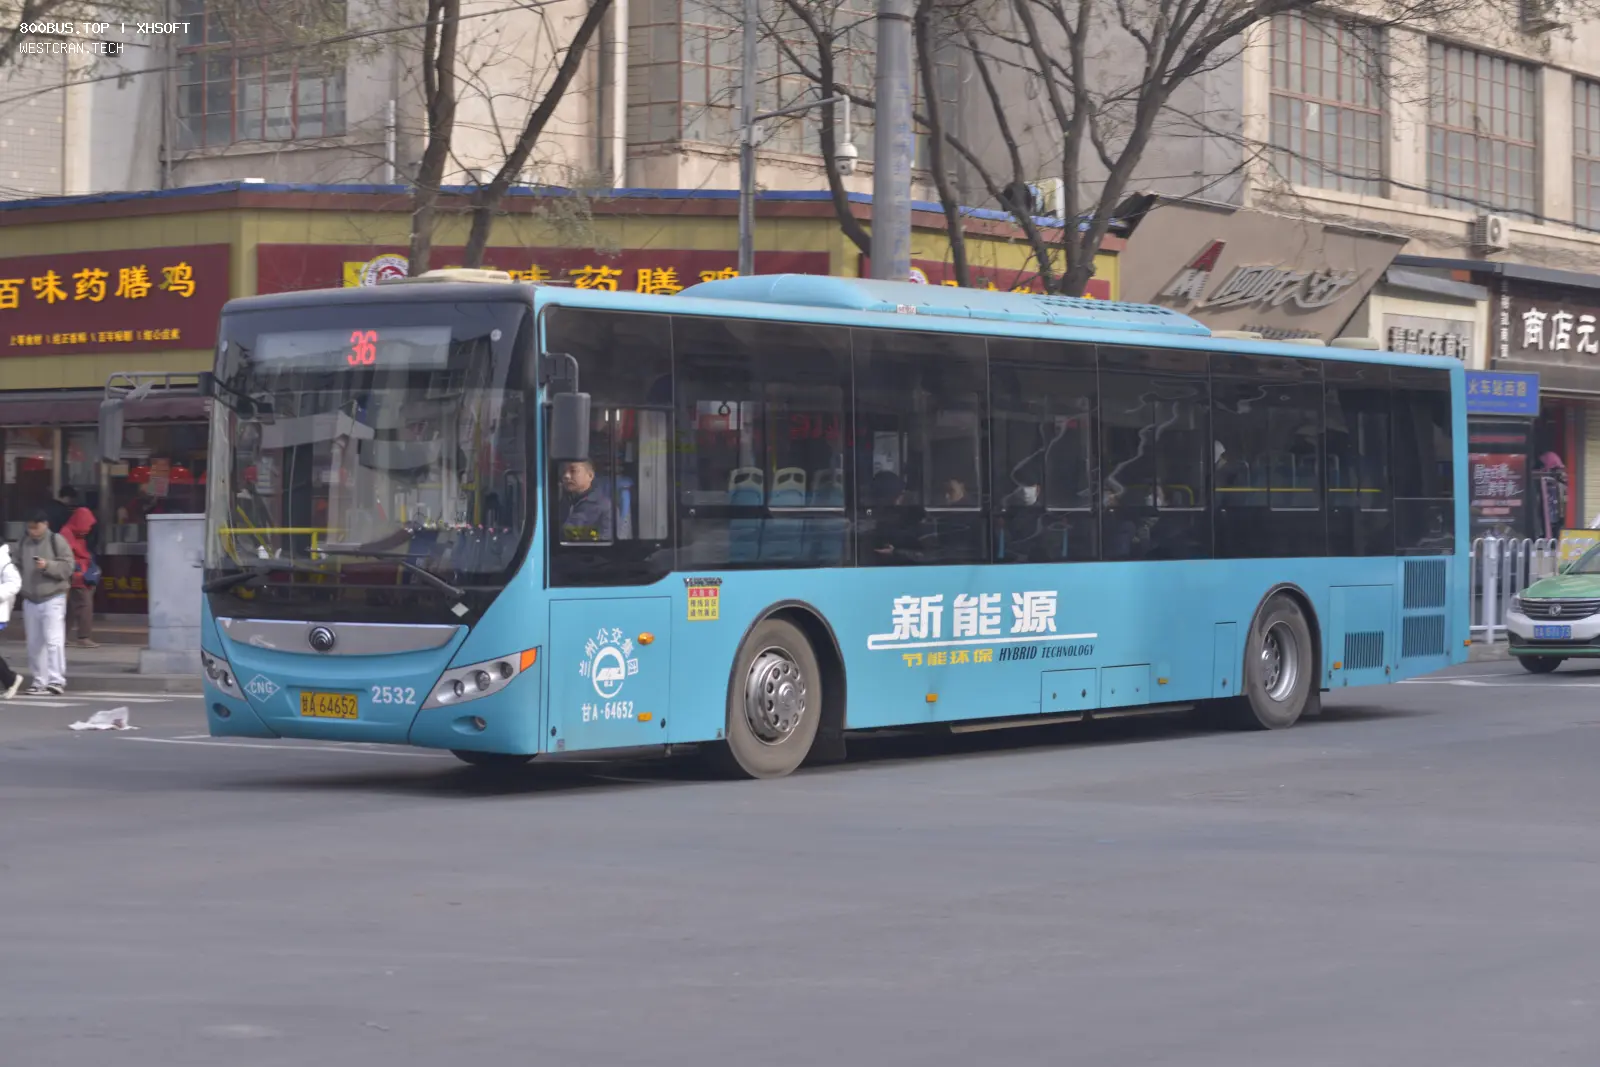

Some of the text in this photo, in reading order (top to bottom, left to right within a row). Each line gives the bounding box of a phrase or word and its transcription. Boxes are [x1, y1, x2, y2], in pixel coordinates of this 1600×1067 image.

[0, 261, 196, 309] 百味药膳鸡
[1522, 307, 1599, 354] 商店元
[347, 329, 377, 366] 36
[890, 590, 1059, 641] 新能源
[902, 648, 993, 667] 节能环保
[999, 644, 1095, 661] HYBRID TECHNOLOGY
[249, 682, 274, 694] CNG
[371, 686, 416, 705] 2532
